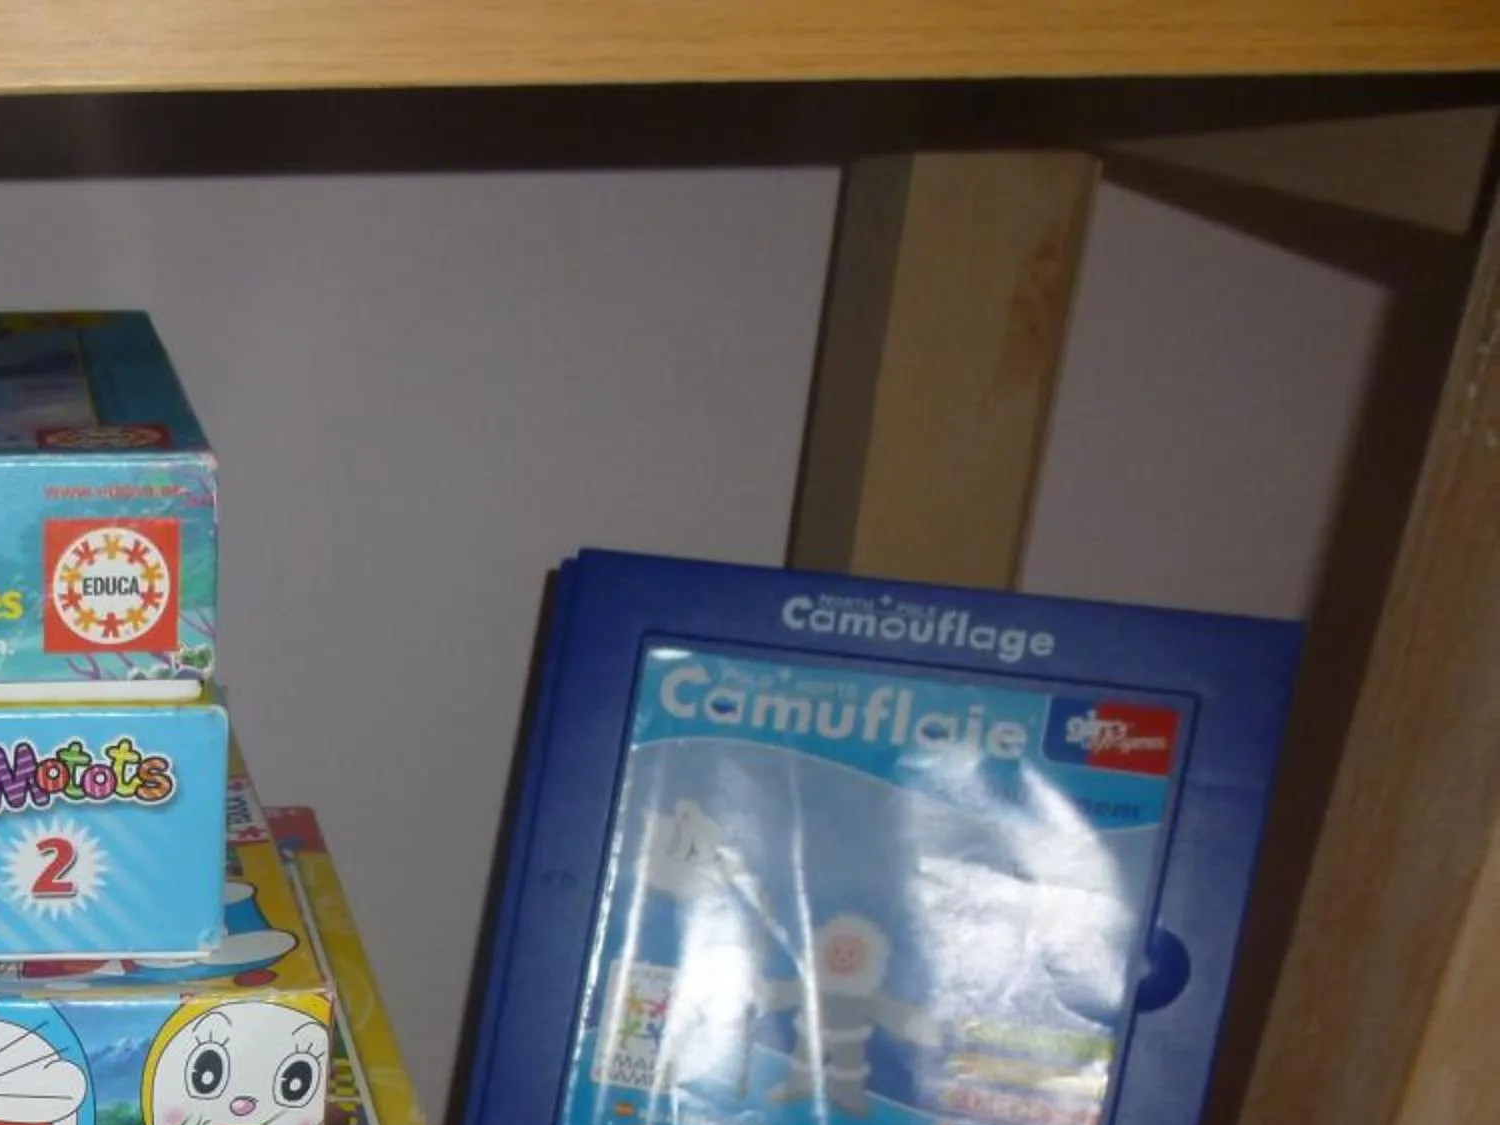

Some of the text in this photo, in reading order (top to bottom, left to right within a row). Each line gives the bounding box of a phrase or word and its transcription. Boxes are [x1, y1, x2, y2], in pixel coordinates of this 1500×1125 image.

[82, 575, 141, 597] EDUCA
[781, 594, 1055, 664] Camouflage
[31, 837, 77, 898] 2
